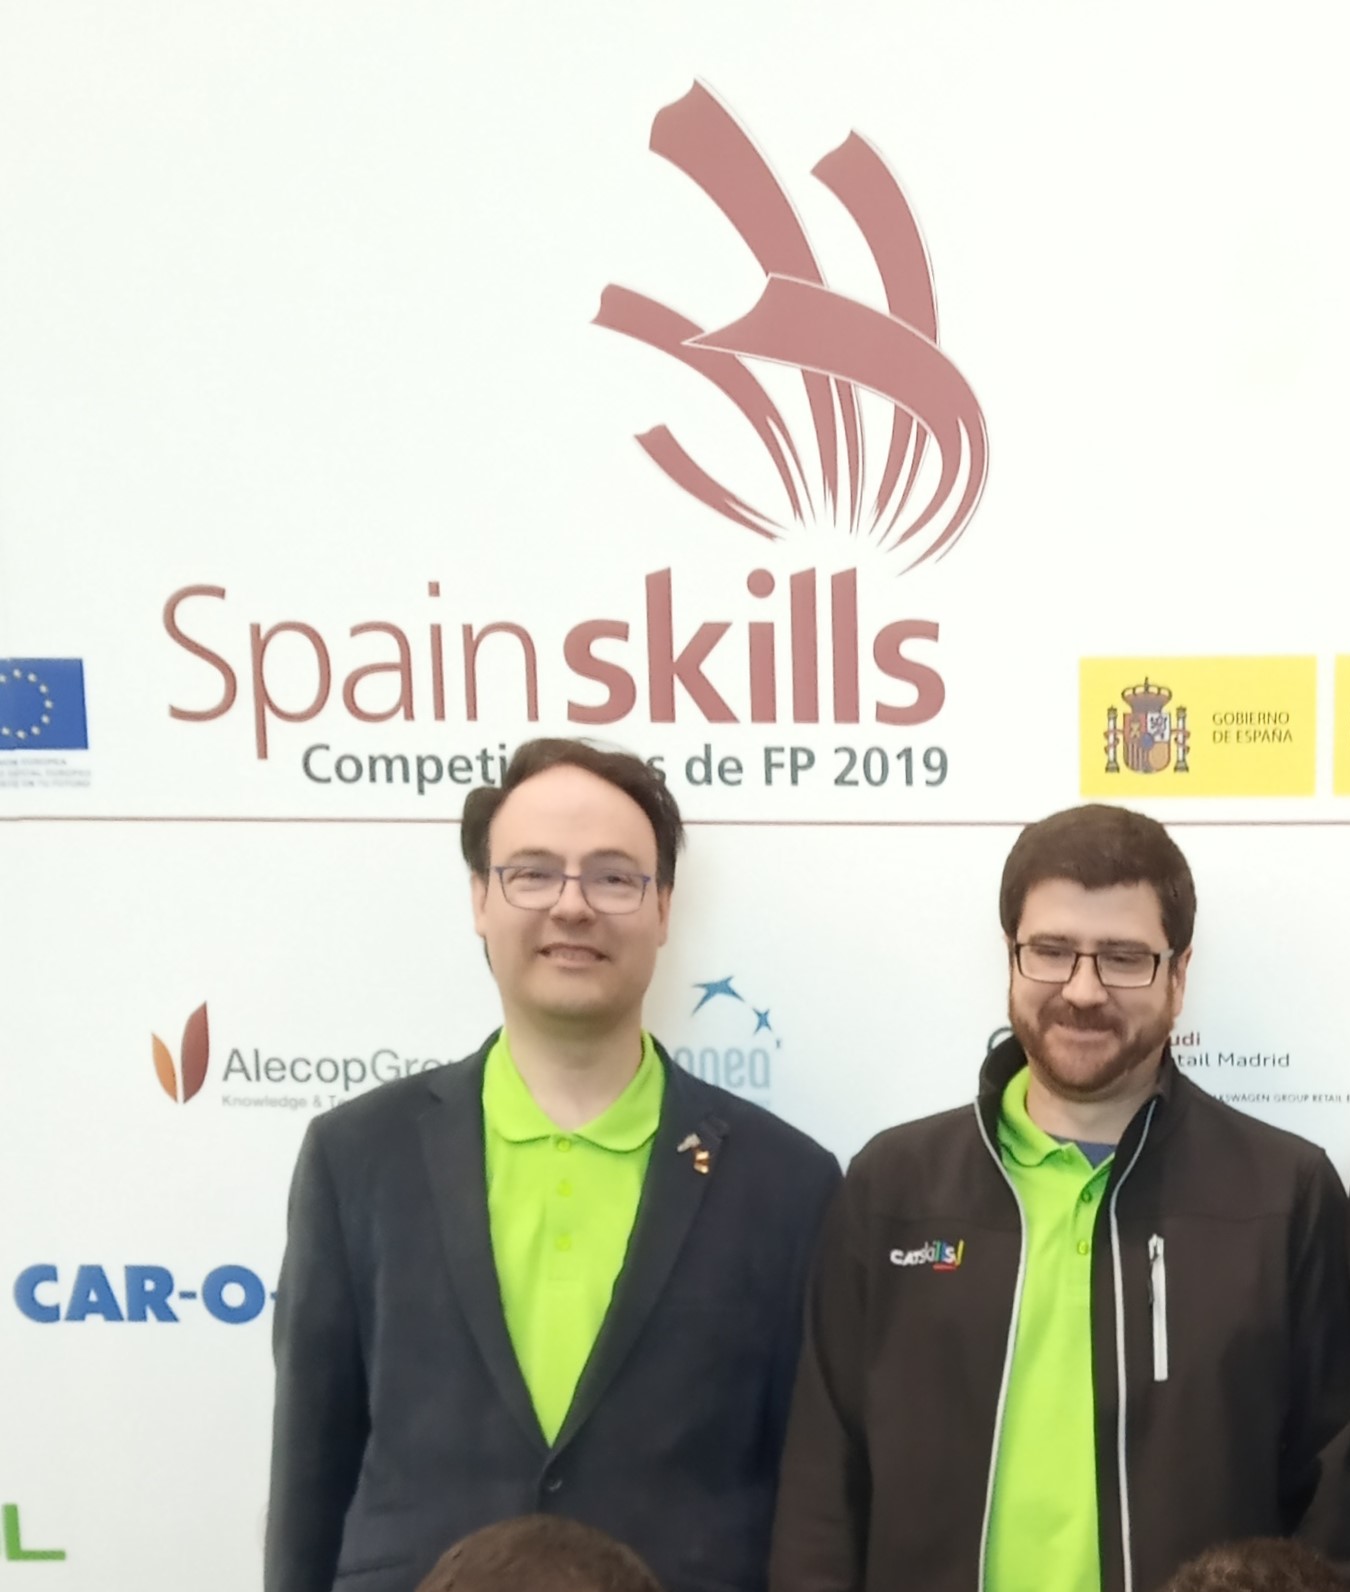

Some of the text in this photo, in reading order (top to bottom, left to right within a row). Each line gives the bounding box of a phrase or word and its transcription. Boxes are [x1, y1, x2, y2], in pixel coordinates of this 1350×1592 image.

[1212, 711, 1290, 726] GOBIERNO
[1212, 727, 1293, 744] DE ESPAÑA
[685, 744, 744, 787] de
[764, 746, 816, 786] FP
[833, 746, 948, 787] 2019
[1170, 1031, 1201, 1047] udi
[1174, 1052, 1291, 1068] tail Madrid
[222, 1047, 460, 1092] AlecopGr
[221, 1093, 308, 1110] Knowledge
[312, 1094, 322, 1109] &
